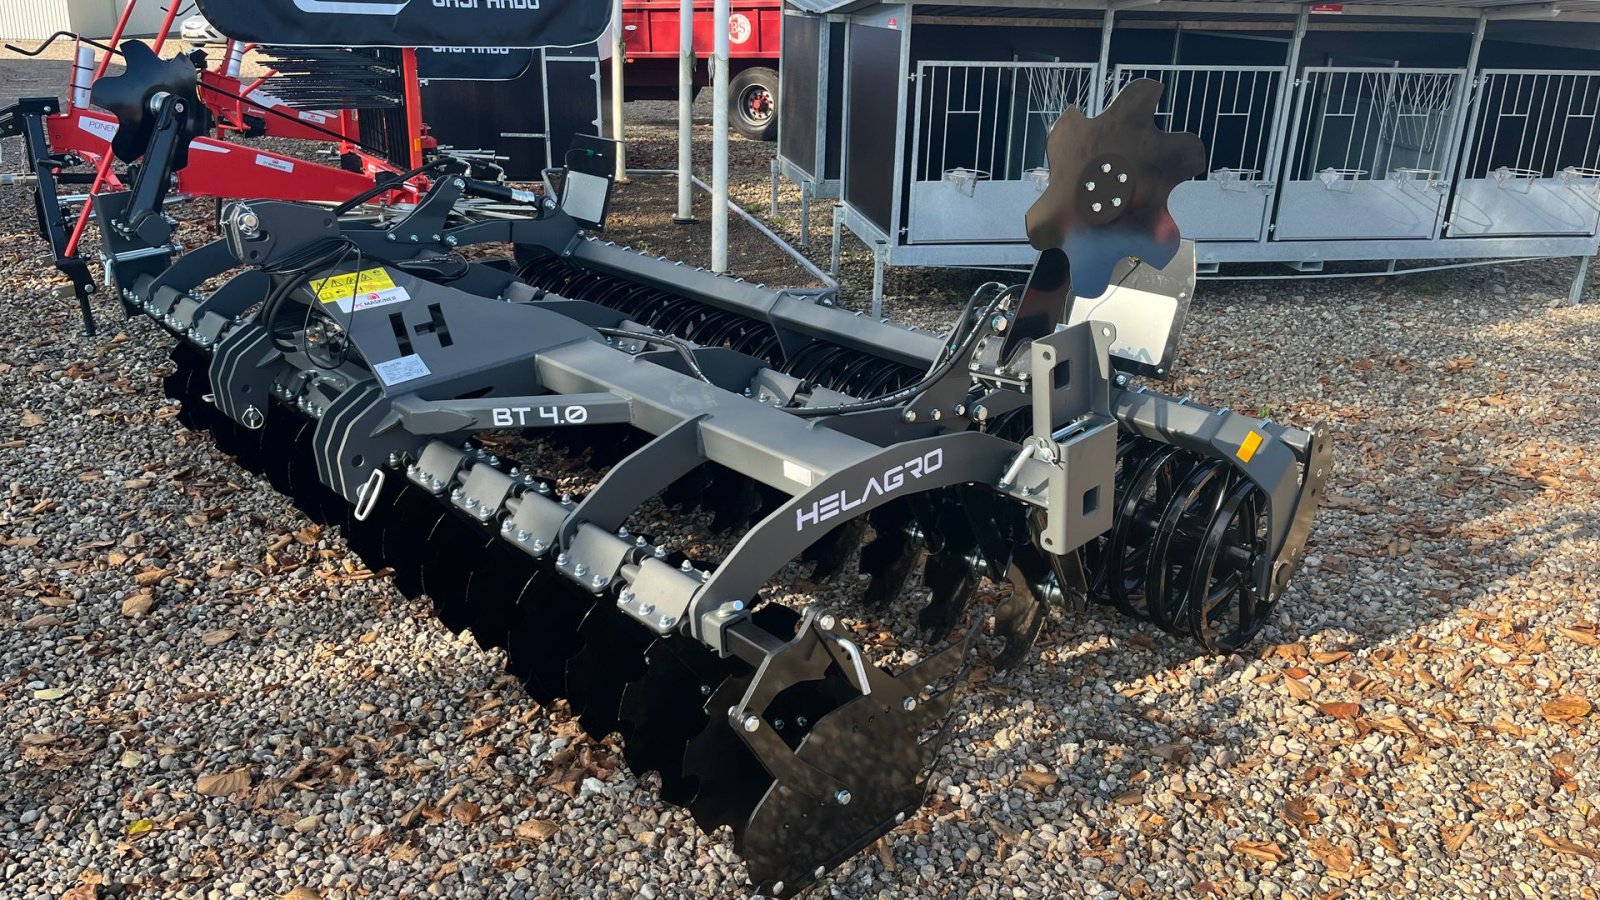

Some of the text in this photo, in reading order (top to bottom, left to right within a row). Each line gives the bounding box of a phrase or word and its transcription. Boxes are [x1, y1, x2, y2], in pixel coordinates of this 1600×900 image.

[492, 405, 588, 427] BT 4.0
[796, 447, 943, 532] HELAGRO
